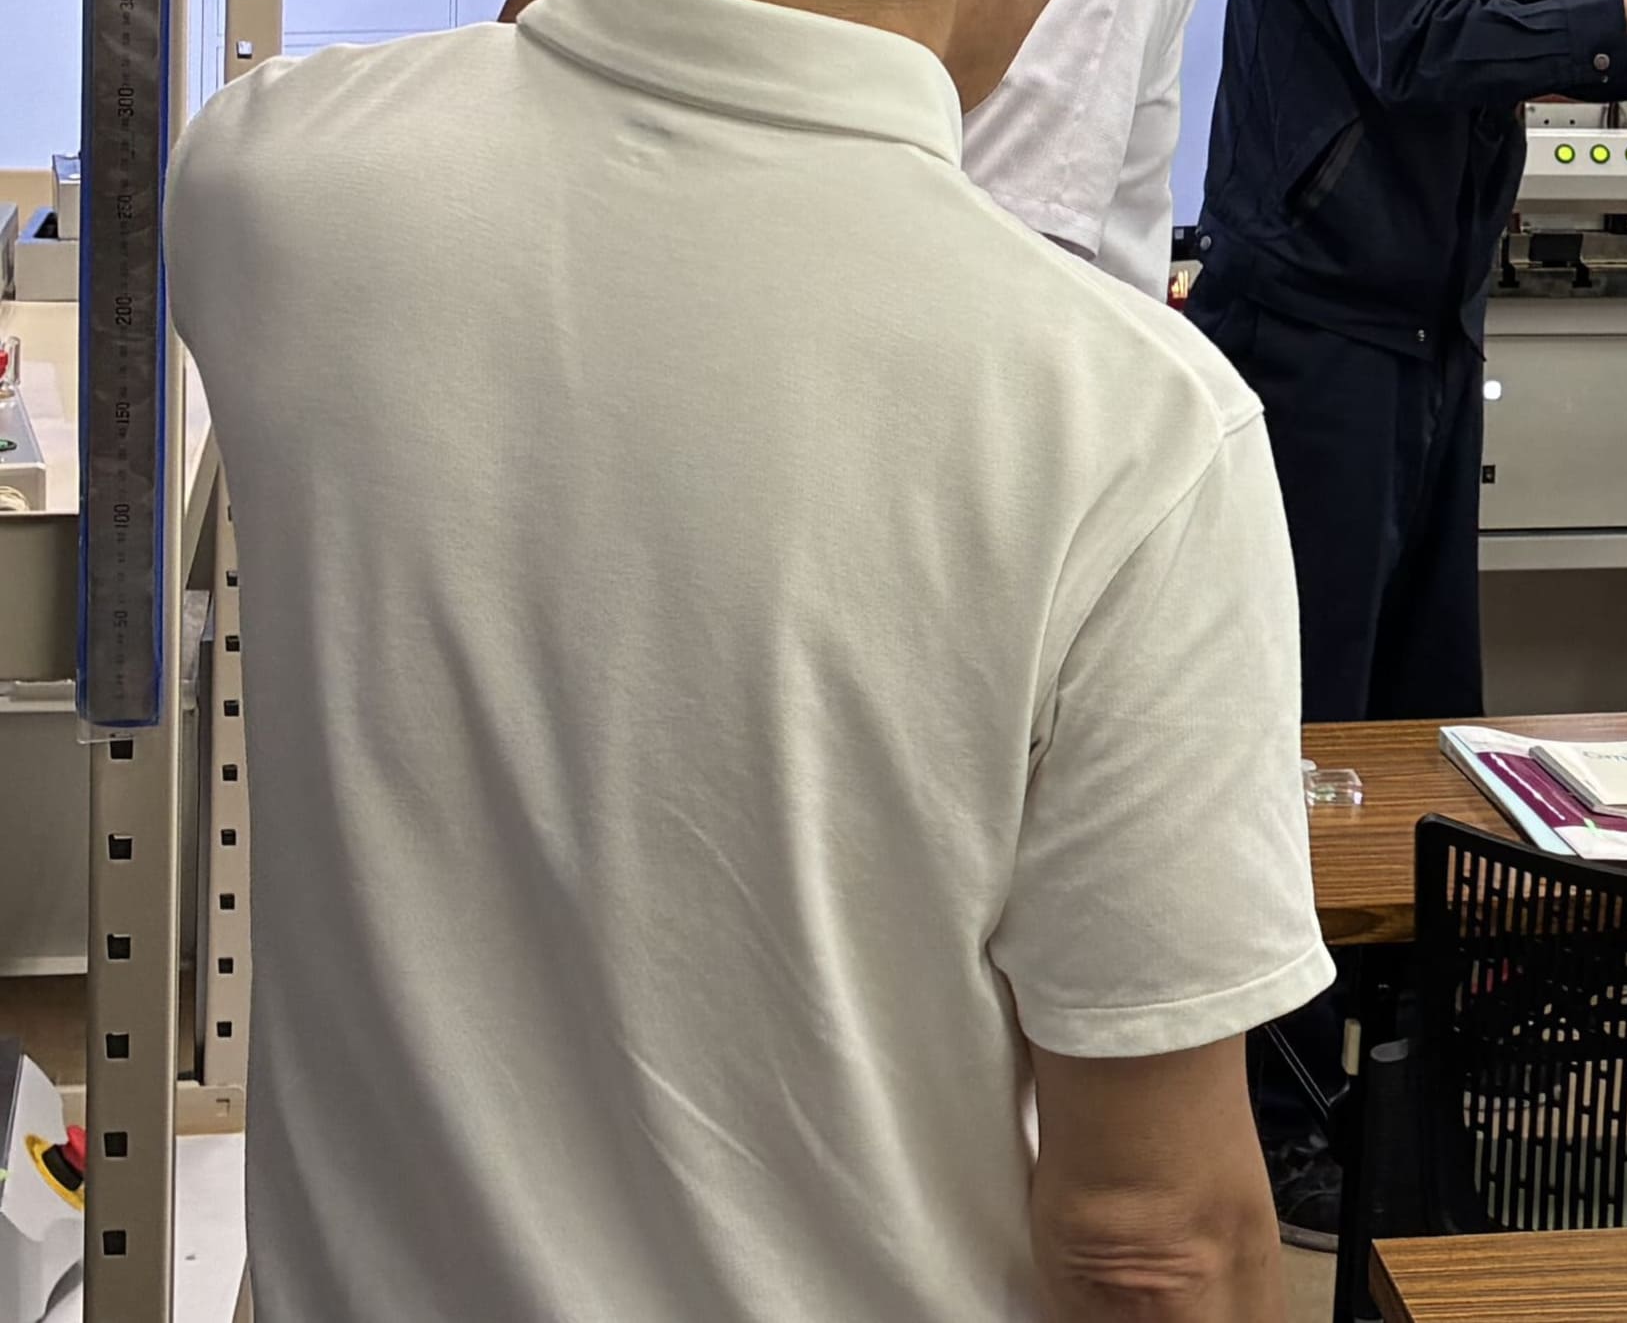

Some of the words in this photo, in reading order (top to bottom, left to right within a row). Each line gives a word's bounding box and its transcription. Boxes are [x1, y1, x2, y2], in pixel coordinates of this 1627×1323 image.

[117, 86, 135, 118] 300
[117, 195, 132, 221] 250
[115, 296, 132, 326] 200
[115, 402, 131, 425] 150
[114, 503, 131, 529] 100
[114, 610, 128, 628] 50
